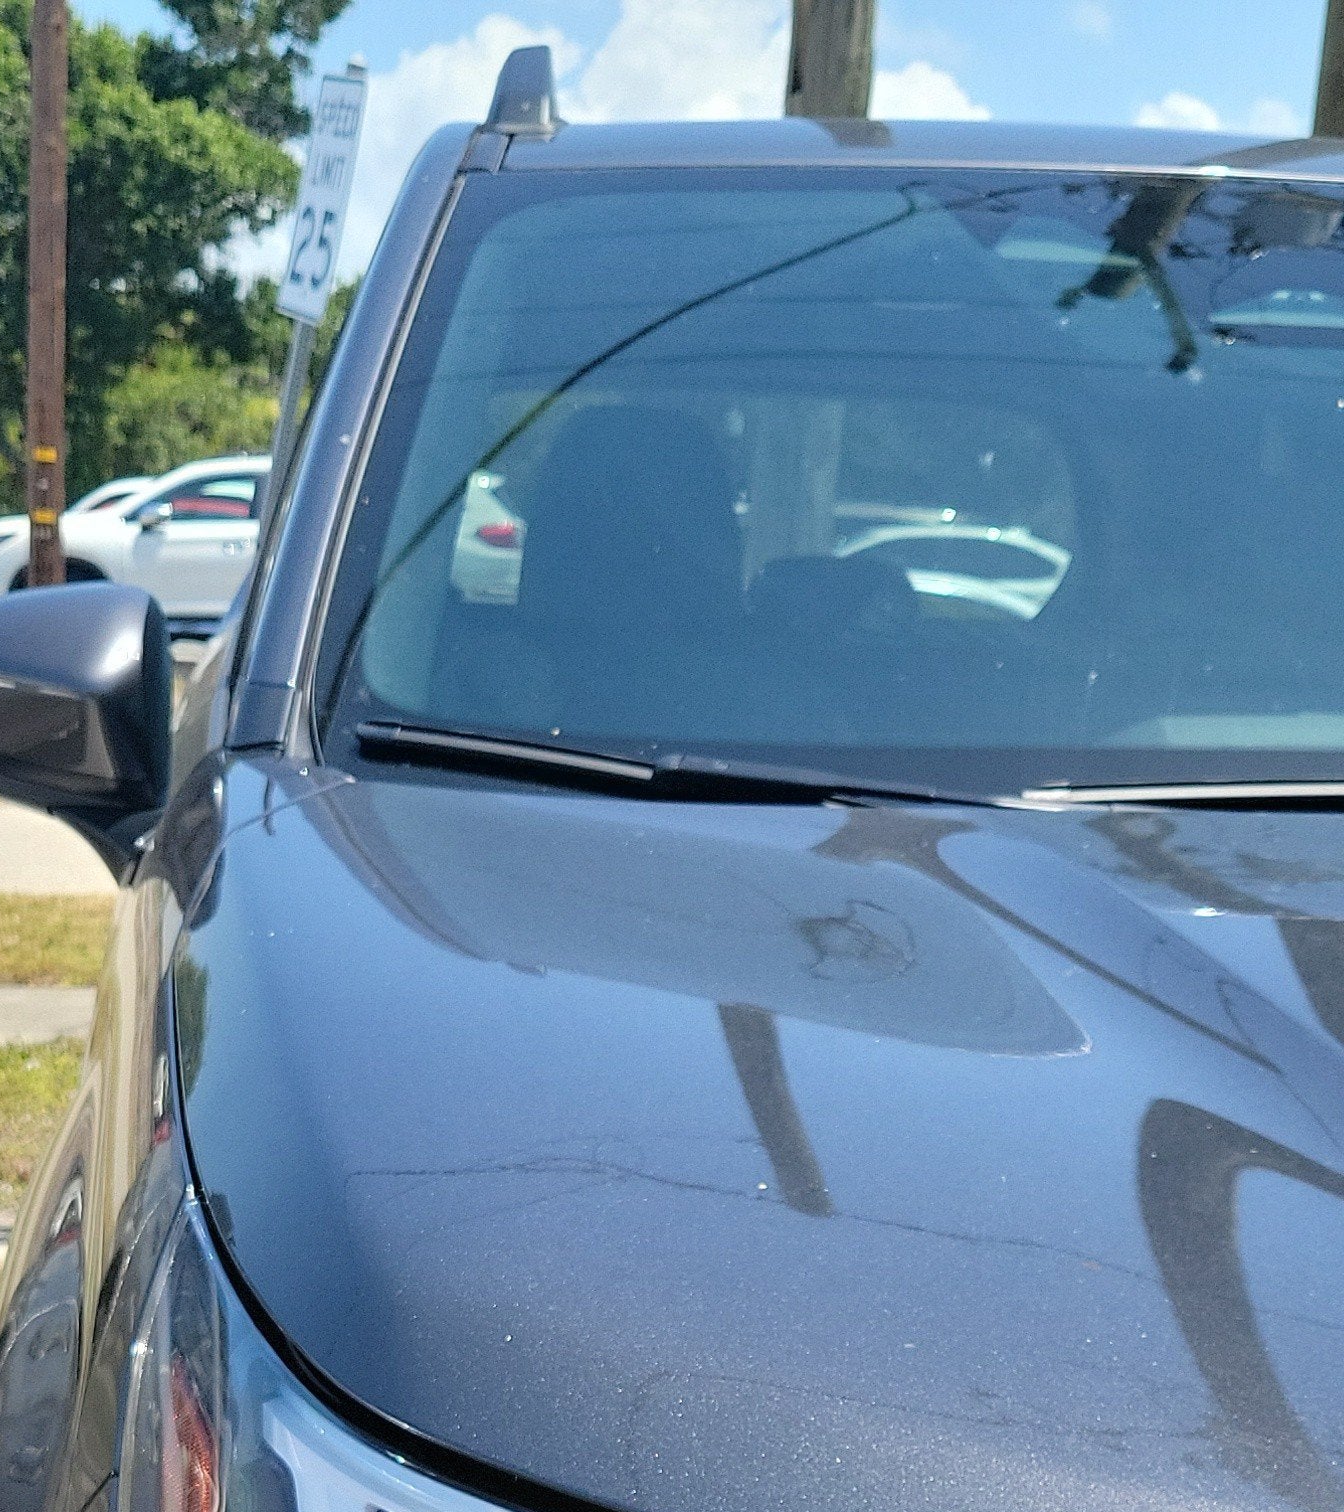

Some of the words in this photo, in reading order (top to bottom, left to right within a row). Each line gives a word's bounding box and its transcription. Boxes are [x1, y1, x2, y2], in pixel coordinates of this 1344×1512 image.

[319, 102, 360, 137] SPEED
[312, 153, 345, 188] LIMIT
[290, 206, 336, 289] 25
